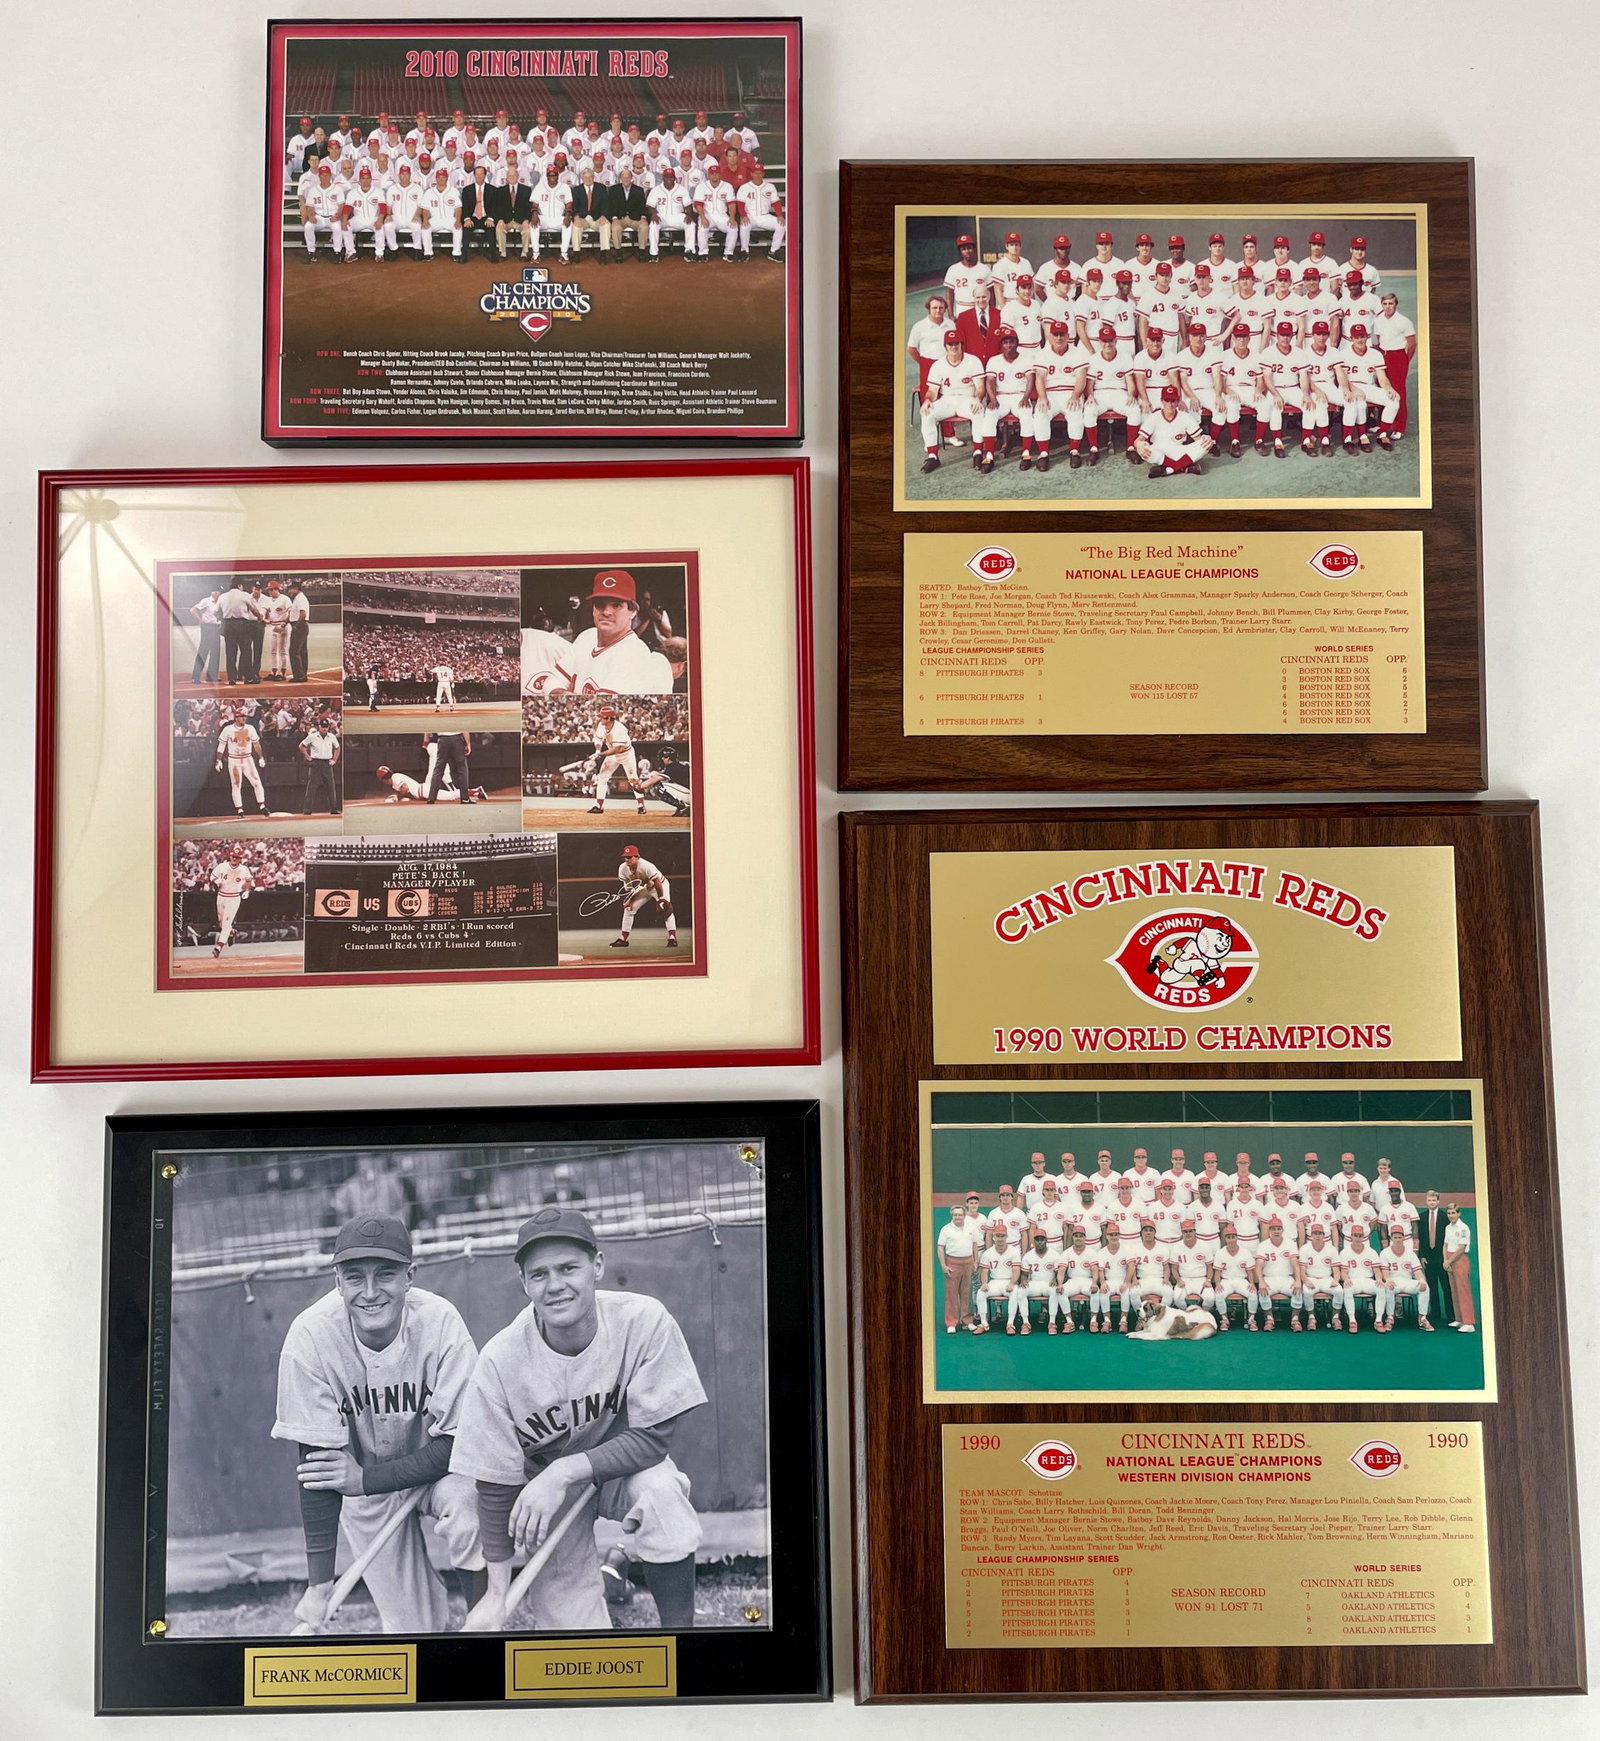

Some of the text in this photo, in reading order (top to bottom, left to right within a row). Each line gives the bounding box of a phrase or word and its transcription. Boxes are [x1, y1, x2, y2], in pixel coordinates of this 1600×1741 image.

[405, 50, 668, 77] 2010 CINCINNATI REDS
[956, 278, 968, 287] 22
[481, 294, 591, 313] CHAMPIONS
[1152, 303, 1165, 313] 43
[1118, 312, 1128, 322] 15
[1118, 546, 1140, 561] Big
[1146, 545, 1172, 558] Red
[983, 559, 1013, 568] REDS
[1326, 556, 1356, 565] REDS
[1066, 568, 1258, 579] NATIONAL LEAGUE CHAMPIONS
[392, 871, 427, 879] PETE'S
[383, 878, 474, 887] MANAGER/PLAYER
[993, 859, 1389, 944] CINCINNATI REDS
[352, 924, 381, 933] Single
[430, 922, 455, 930] RBI's
[1139, 917, 1202, 946] CINCINNATI
[1154, 983, 1211, 1004] REDS
[995, 1024, 1391, 1051] 1990 WORLD CHAMPIONS
[960, 1435, 1000, 1449] 1990
[1121, 1433, 1306, 1448] CINCINNATI REDS
[1428, 1433, 1468, 1448] 1990
[1041, 1456, 1074, 1465] REDS
[1106, 1455, 1321, 1466] NATIONAL LEAGUE CHAMPIONS
[1368, 1455, 1399, 1464] REDS
[1118, 1472, 1310, 1482] WESTERN DIVISION CHAMPIONS
[961, 1568, 1023, 1576] CINCINNATI
[1028, 1567, 1054, 1576] REDS
[1300, 1578, 1362, 1587] CINCINNATI
[1367, 1578, 1394, 1587] REDS
[1171, 1587, 1265, 1597] SEASON RECORD
[1174, 1601, 1262, 1611] WON 91 LOST 71
[545, 1660, 643, 1675] EDDIE JOOST
[261, 1667, 402, 1682] FRANK McCORMICK
